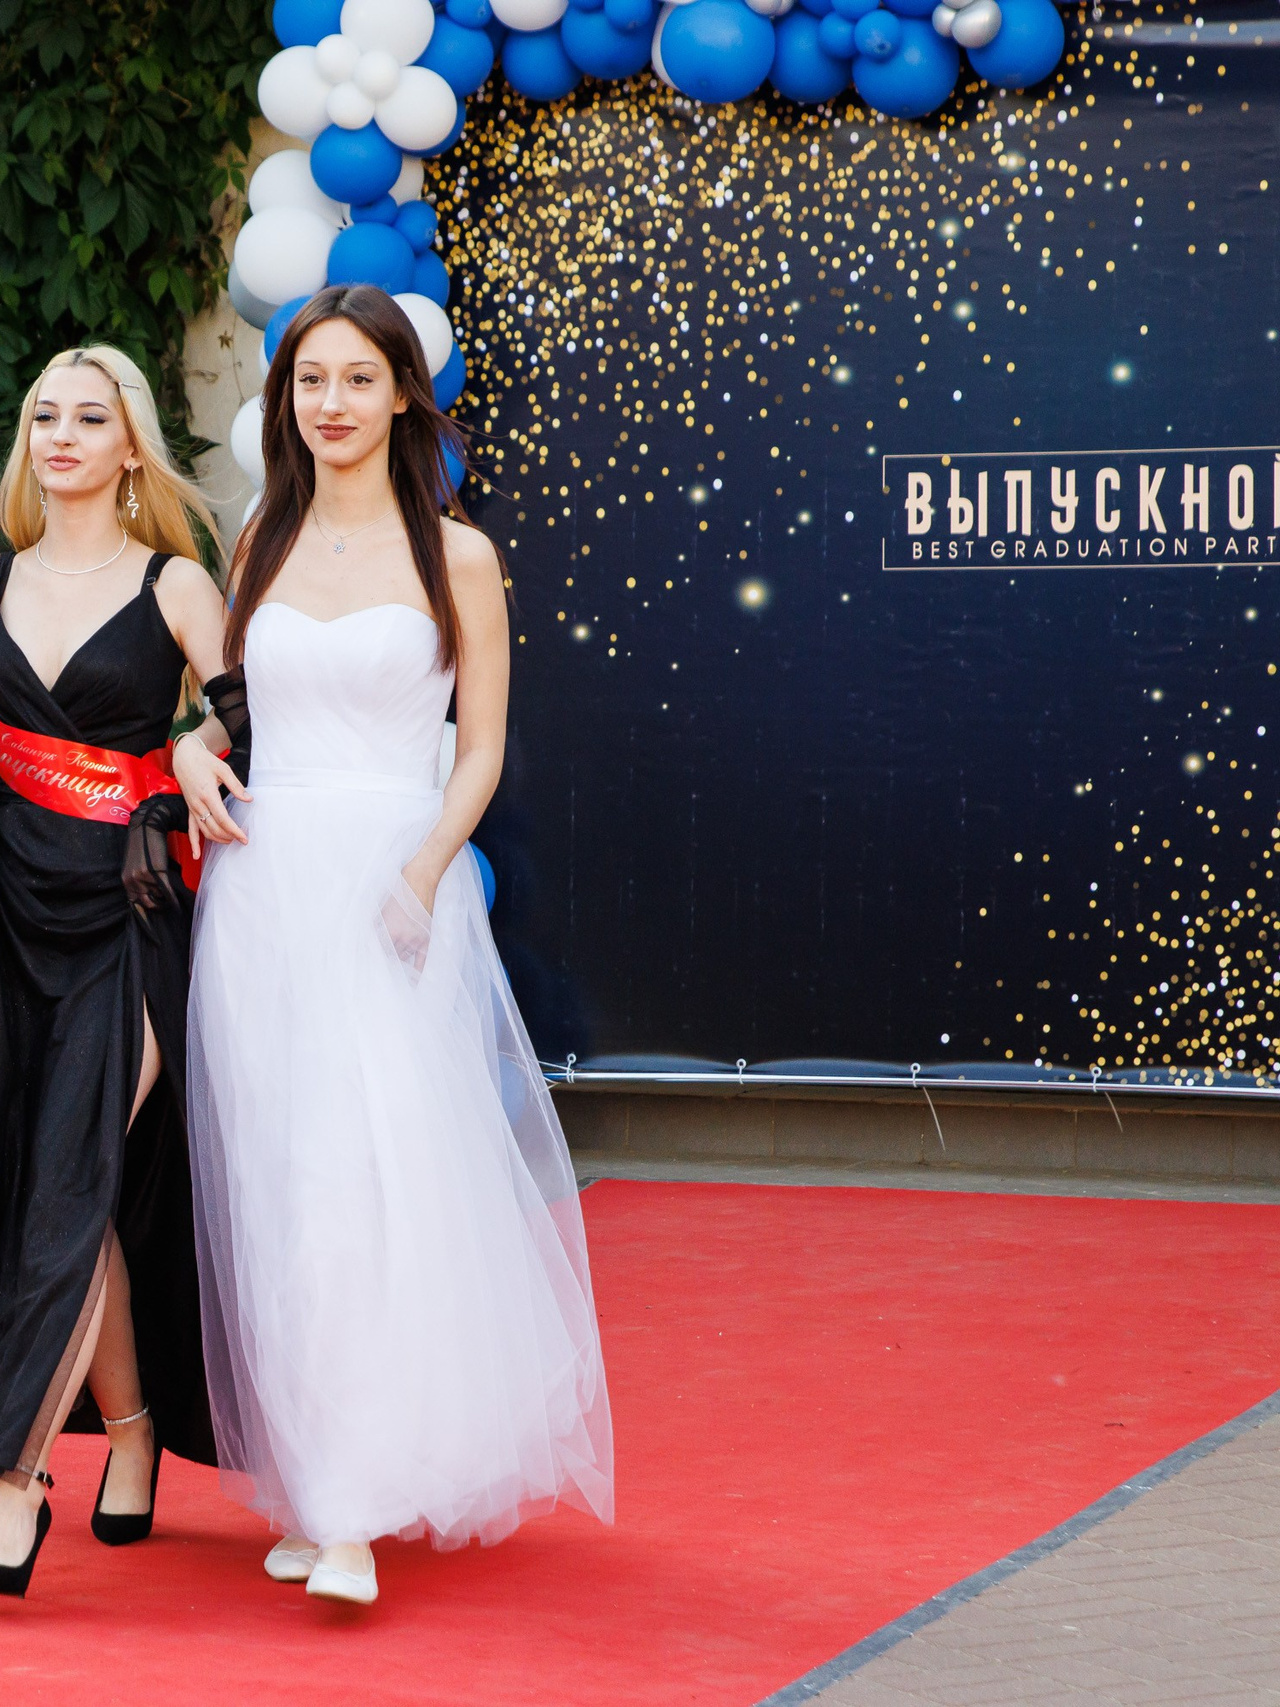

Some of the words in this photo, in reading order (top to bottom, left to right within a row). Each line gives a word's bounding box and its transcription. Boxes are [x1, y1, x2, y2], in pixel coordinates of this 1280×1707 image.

[912, 540, 975, 560] BEST
[990, 537, 1188, 559] GRADUATION
[1205, 535, 1277, 556] PART
[65, 749, 120, 774] Карина
